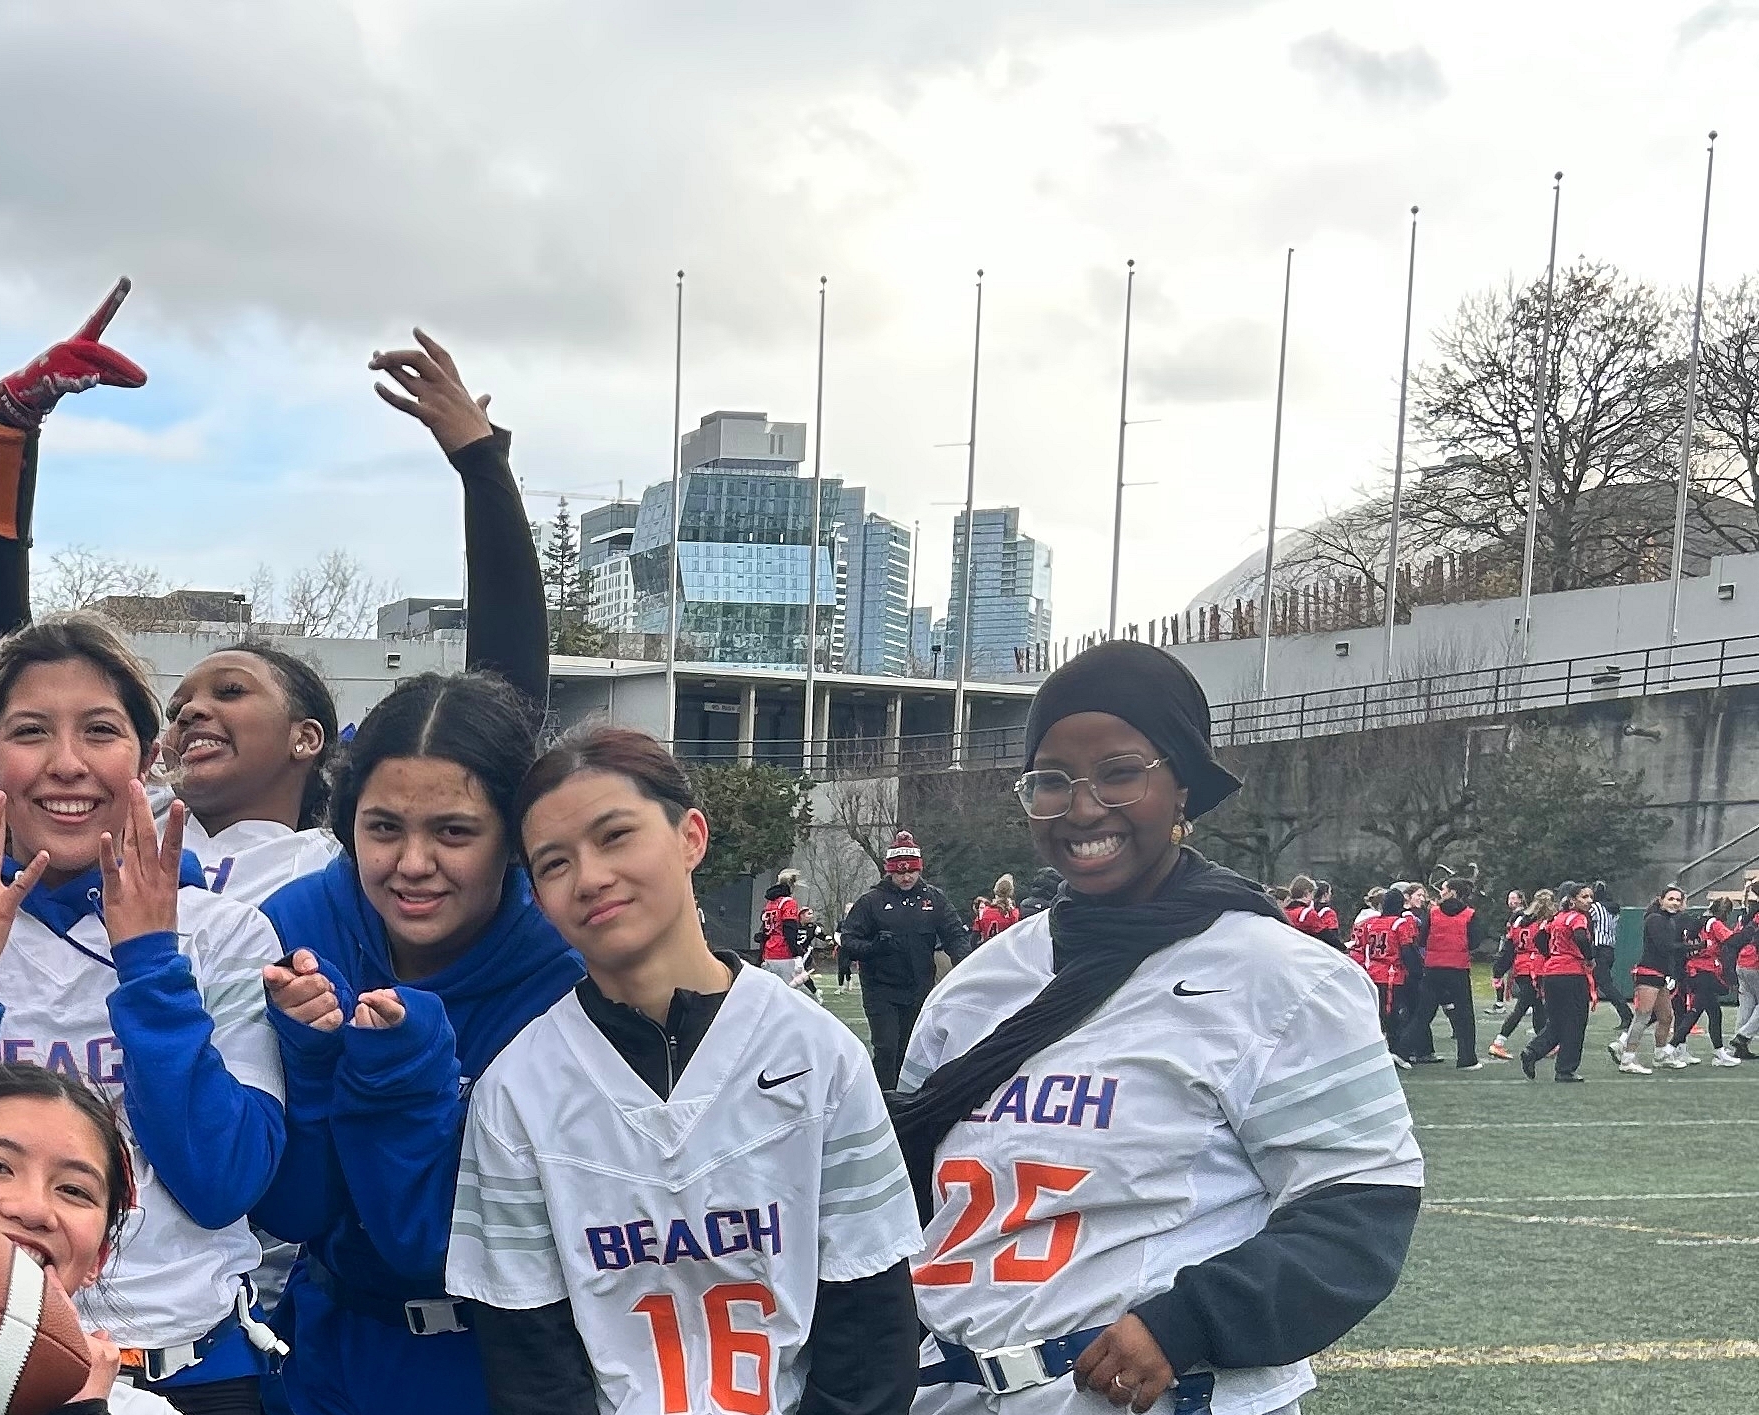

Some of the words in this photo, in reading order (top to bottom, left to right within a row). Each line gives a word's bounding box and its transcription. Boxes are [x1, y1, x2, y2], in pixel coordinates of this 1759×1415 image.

[961, 1074, 1119, 1129] ACH
[584, 1203, 781, 1272] BEACH
[910, 1156, 1095, 1288] 25
